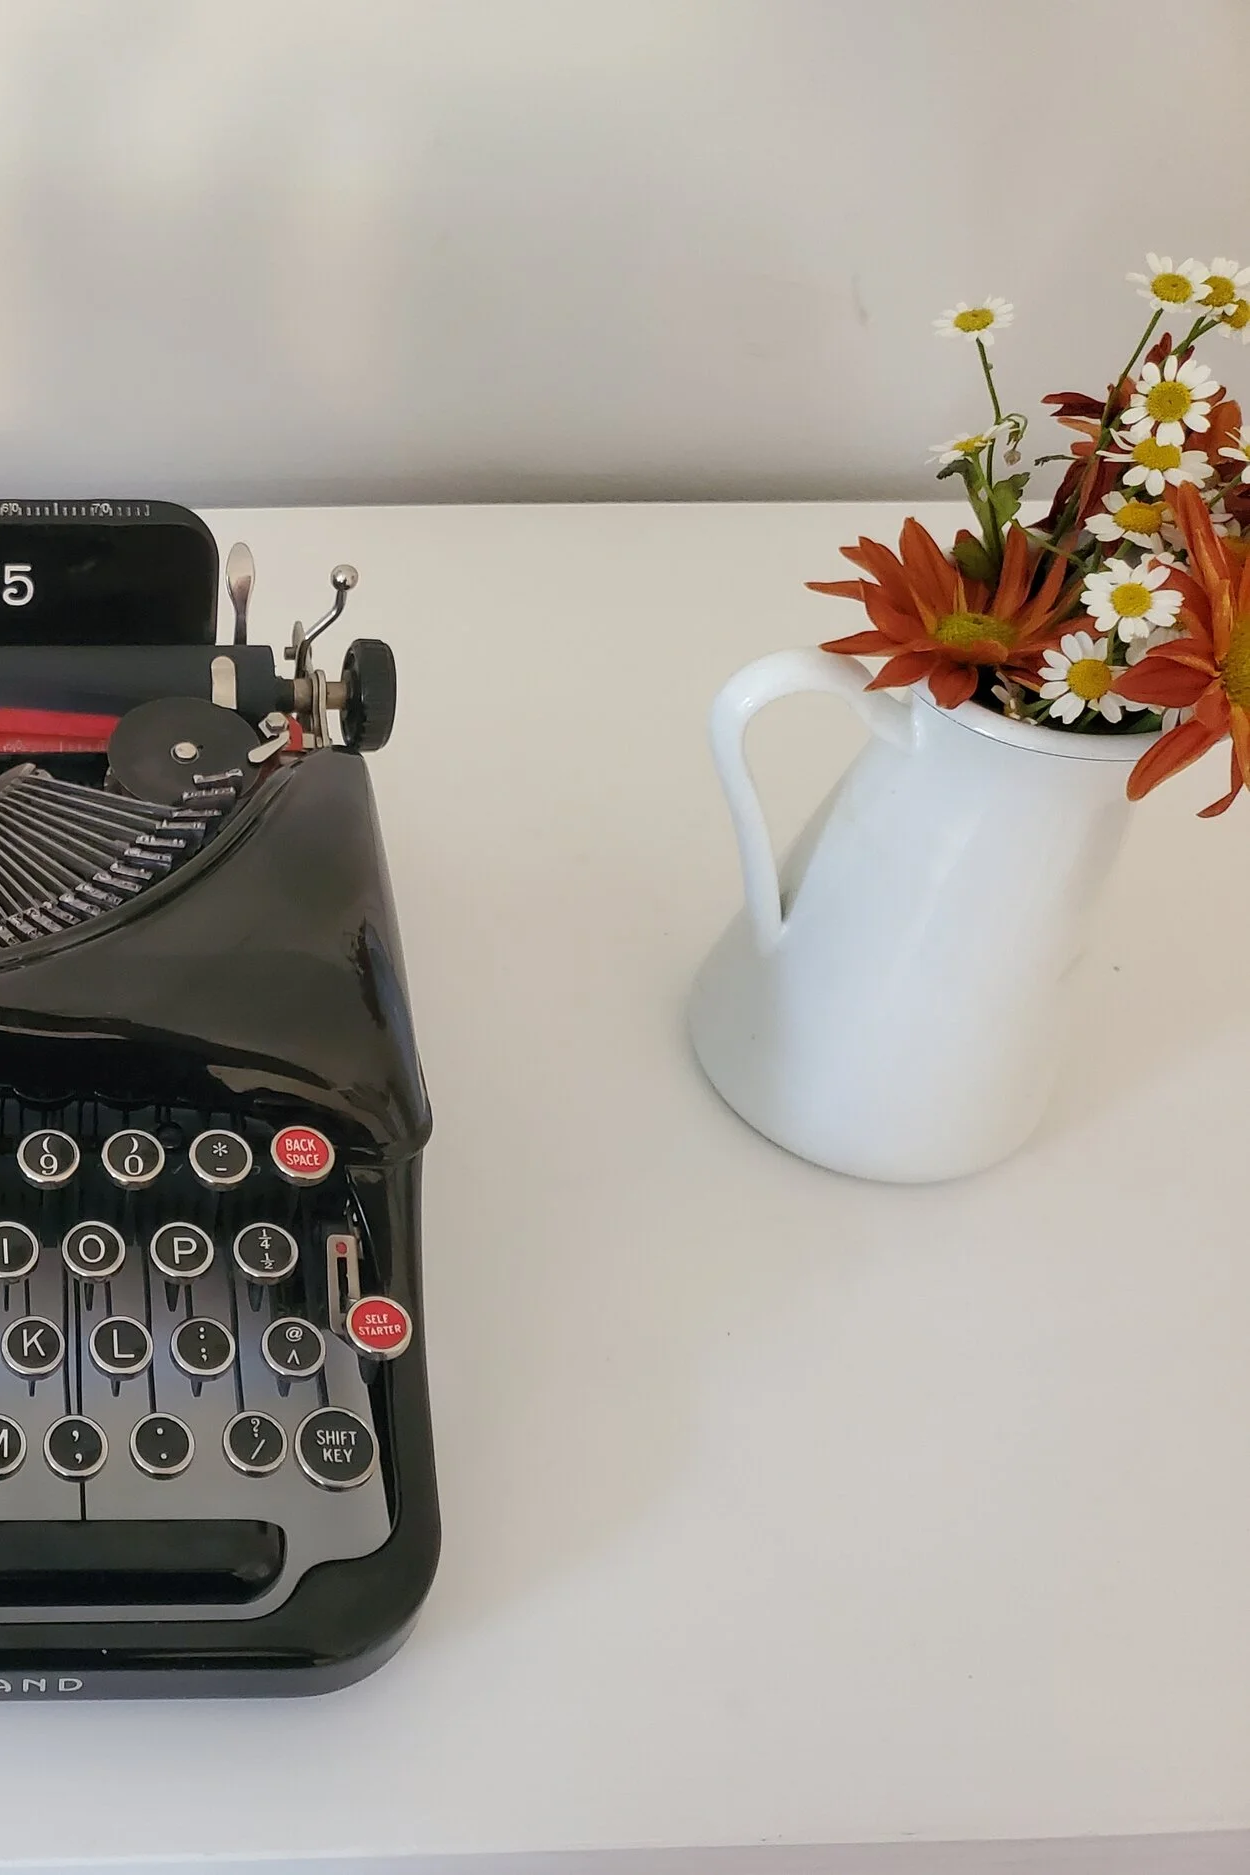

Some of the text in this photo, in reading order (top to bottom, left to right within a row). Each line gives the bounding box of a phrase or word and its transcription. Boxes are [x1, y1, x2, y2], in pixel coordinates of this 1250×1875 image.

[1, 502, 20, 514] 60
[91, 502, 110, 515] 70
[1, 563, 35, 607] 5
[42, 1136, 51, 1154] (
[130, 1136, 139, 1154] )
[285, 1138, 317, 1152] BACK
[39, 1153, 59, 1176] 9
[124, 1154, 144, 1176] 0
[286, 1153, 321, 1166] SPACE
[78, 1234, 106, 1263] O
[173, 1237, 197, 1264] P
[365, 1313, 388, 1325] SELF
[285, 1326, 303, 1342] @
[358, 1323, 402, 1336] STARTER
[22, 1328, 46, 1357] K
[112, 1328, 135, 1359] L
[250, 1417, 261, 1438] ?
[316, 1429, 357, 1446] SHIFT
[250, 1439, 266, 1460] /
[322, 1447, 353, 1463] KEY
